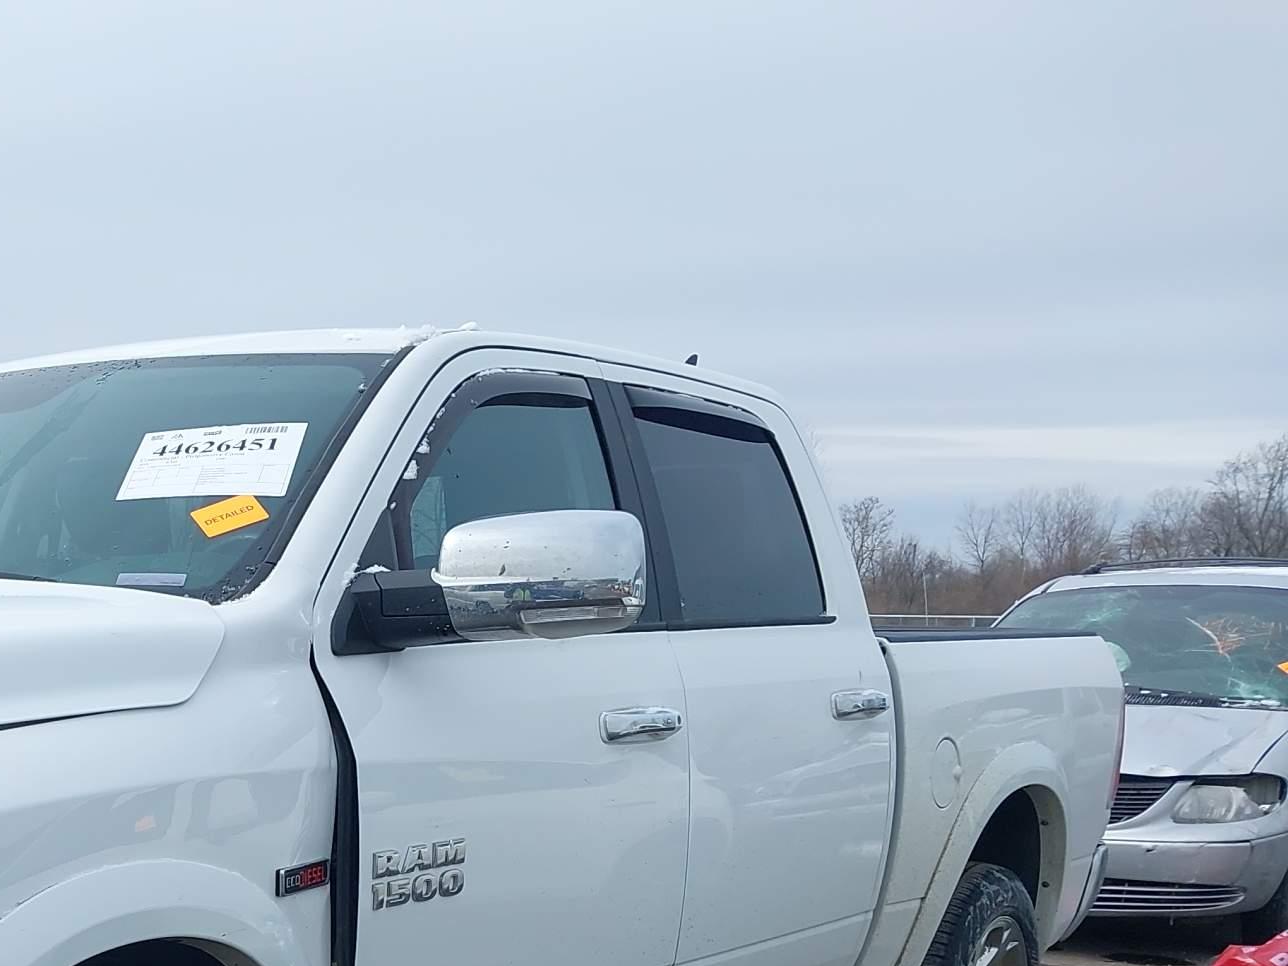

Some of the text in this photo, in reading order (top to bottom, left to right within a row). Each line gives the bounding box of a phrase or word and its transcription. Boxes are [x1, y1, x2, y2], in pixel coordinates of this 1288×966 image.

[153, 437, 278, 457] 44626451
[204, 505, 254, 526] DETAILED
[372, 837, 466, 879] RAM
[371, 867, 465, 911] 1500
